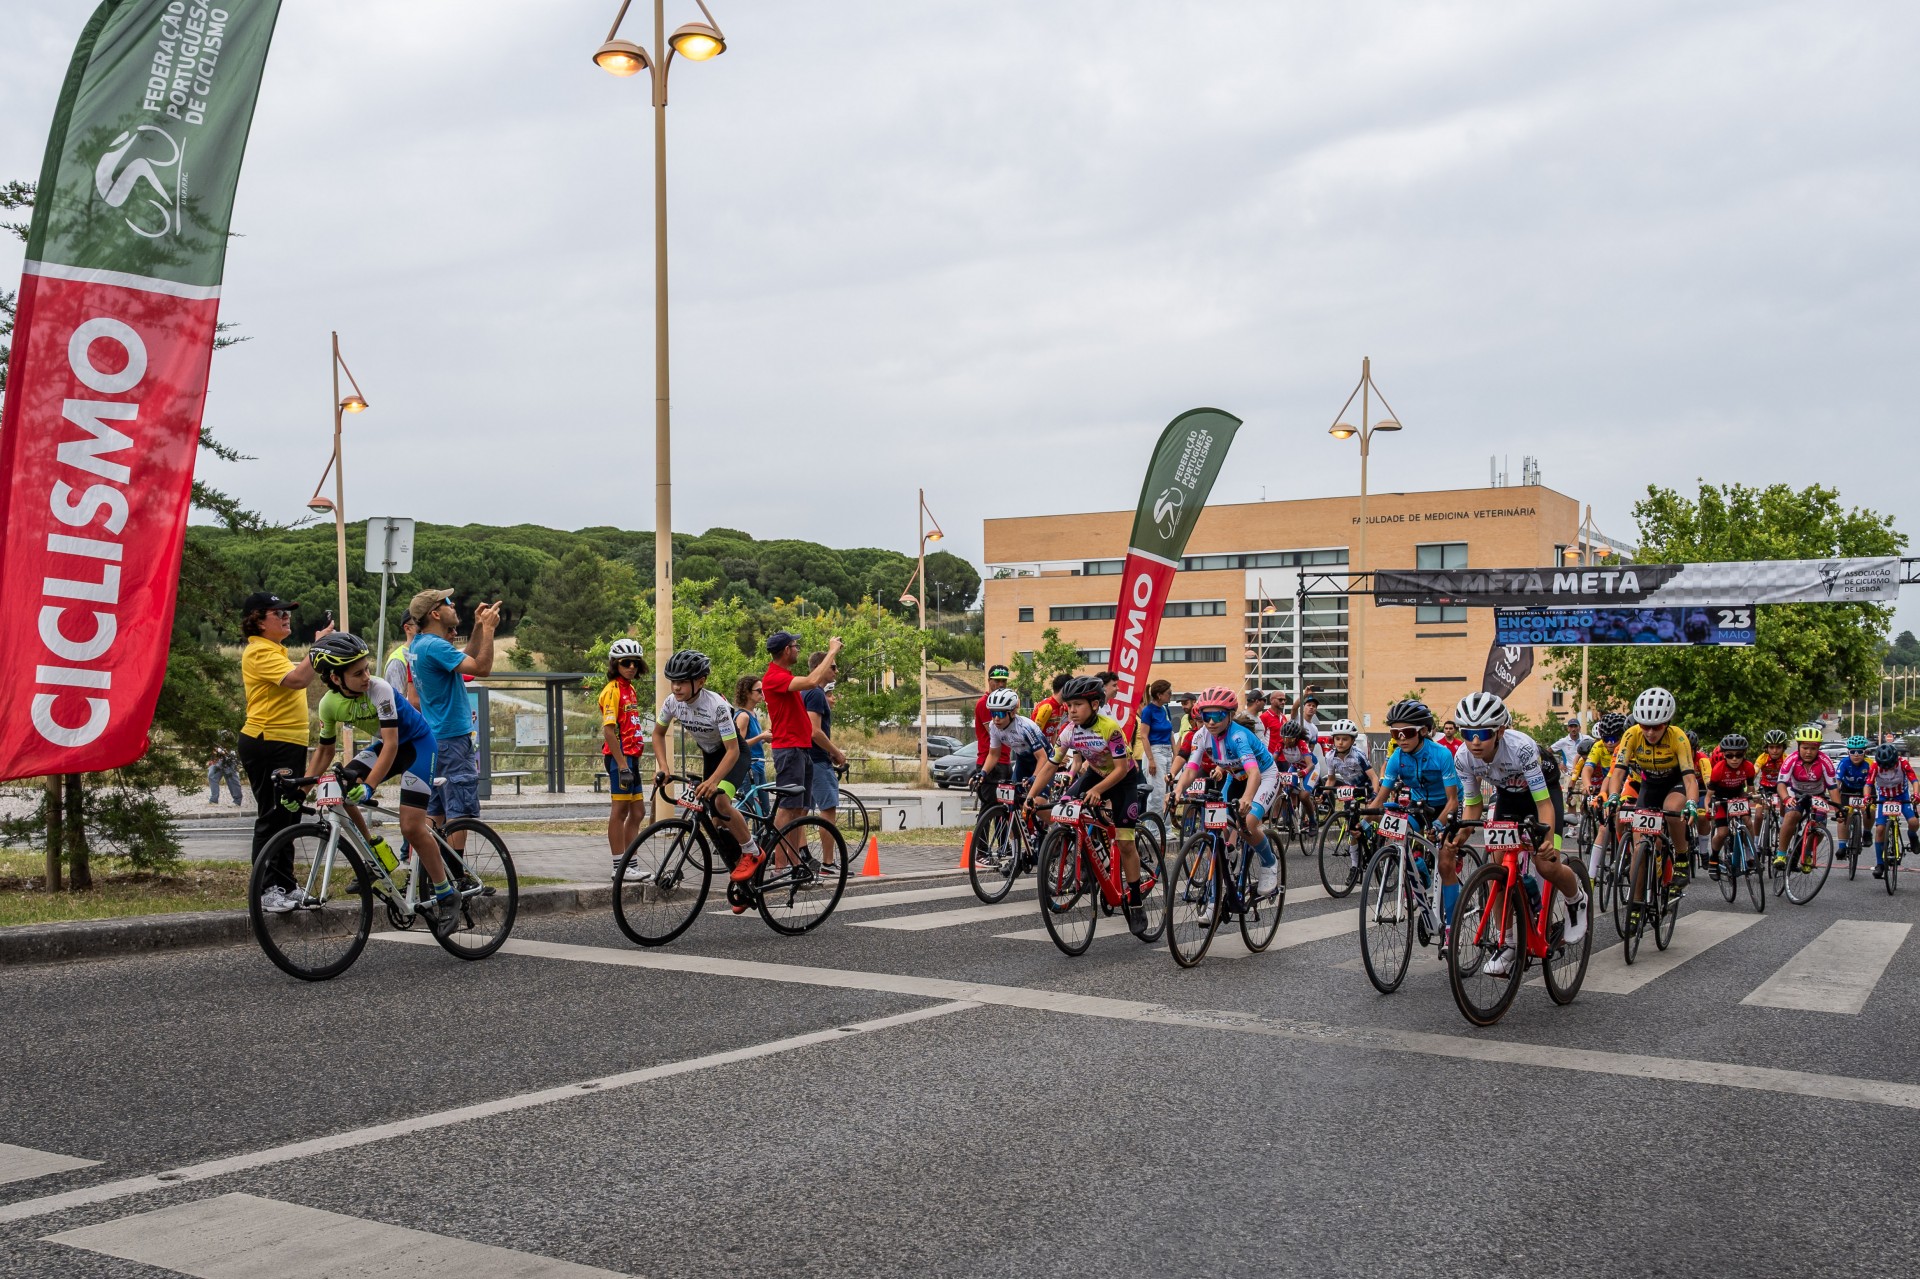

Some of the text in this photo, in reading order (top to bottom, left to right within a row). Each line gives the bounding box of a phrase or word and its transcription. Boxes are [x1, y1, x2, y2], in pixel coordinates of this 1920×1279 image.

[143, 1, 185, 112] FEDERAÇÃO
[166, 0, 209, 120] PORTUGUESA
[185, 8, 229, 125] DE CICLISMO
[1174, 430, 1198, 482] FEDERAÇÃO
[1181, 429, 1208, 486] PORTUGUESA
[1188, 435, 1213, 489] DE CICLISMO
[1409, 514, 1420, 522] DE
[1424, 511, 1469, 521] MEDICINA
[1474, 507, 1536, 519] VETERINÁRIA
[31, 317, 147, 747] CICLISMO
[1845, 569, 1890, 577] ASSOCIAÇÃO
[1461, 573, 1544, 596] META
[1552, 571, 1640, 595] META
[1498, 615, 1593, 629] ENCONTRO
[1717, 610, 1751, 629] 23
[1498, 630, 1577, 643] ESCOLAS
[1718, 630, 1750, 640] MAIO
[1113, 573, 1153, 729] CLISMO
[323, 783, 329, 798] 1
[1001, 789, 1010, 800] 71
[937, 801, 943, 826] 1
[1058, 803, 1075, 817] 76
[1733, 802, 1745, 812] 30
[1884, 804, 1900, 812] 103
[898, 809, 907, 831] 2
[1208, 809, 1217, 822] 7
[1639, 816, 1656, 829] 20
[1383, 816, 1400, 832] 64
[1488, 829, 1517, 845] 271
